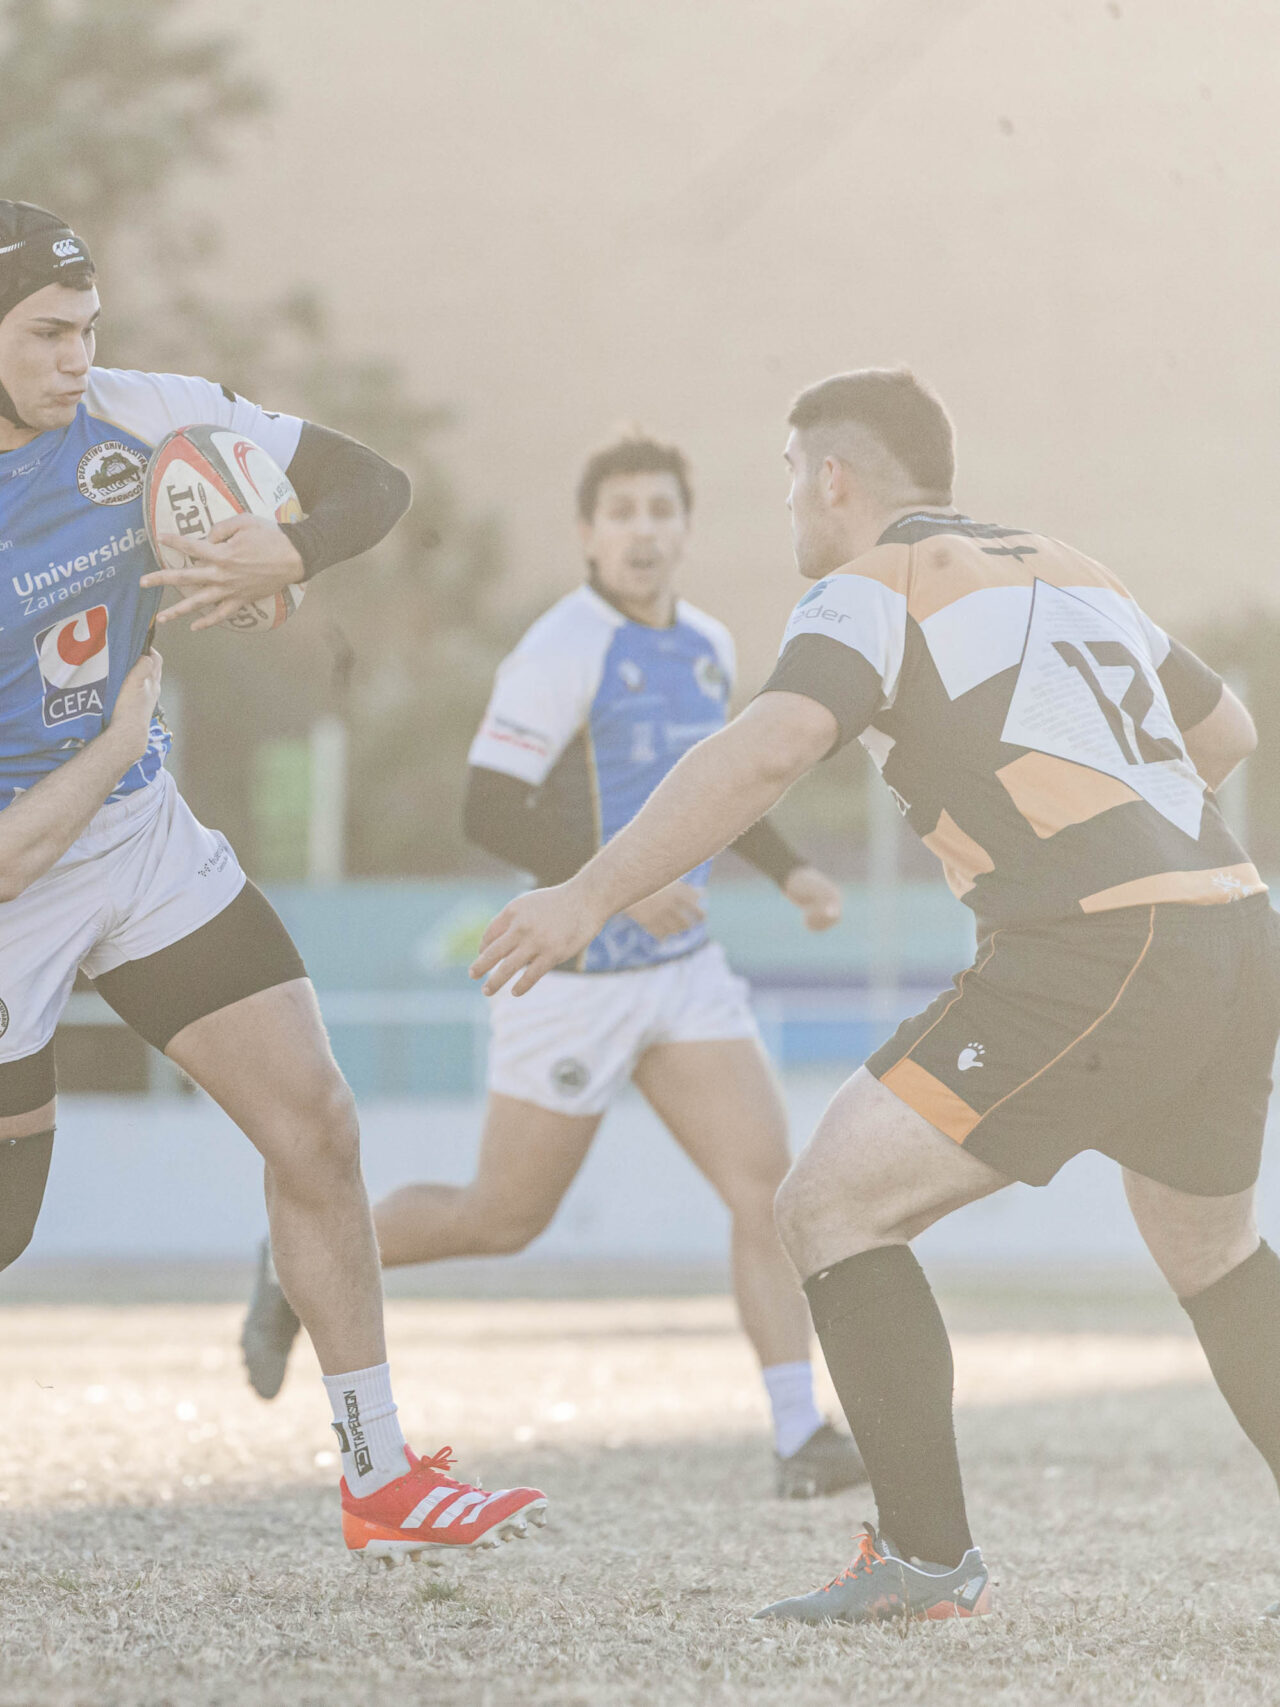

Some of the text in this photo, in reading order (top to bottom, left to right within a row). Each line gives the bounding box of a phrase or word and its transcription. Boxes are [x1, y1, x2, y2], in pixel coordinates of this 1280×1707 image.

[12, 524, 148, 598] Universida
[20, 564, 117, 616] Zaragoza
[49, 688, 103, 720] CEFA
[1050, 640, 1184, 766] 12
[342, 1389, 366, 1449] TAPEDESIGN
